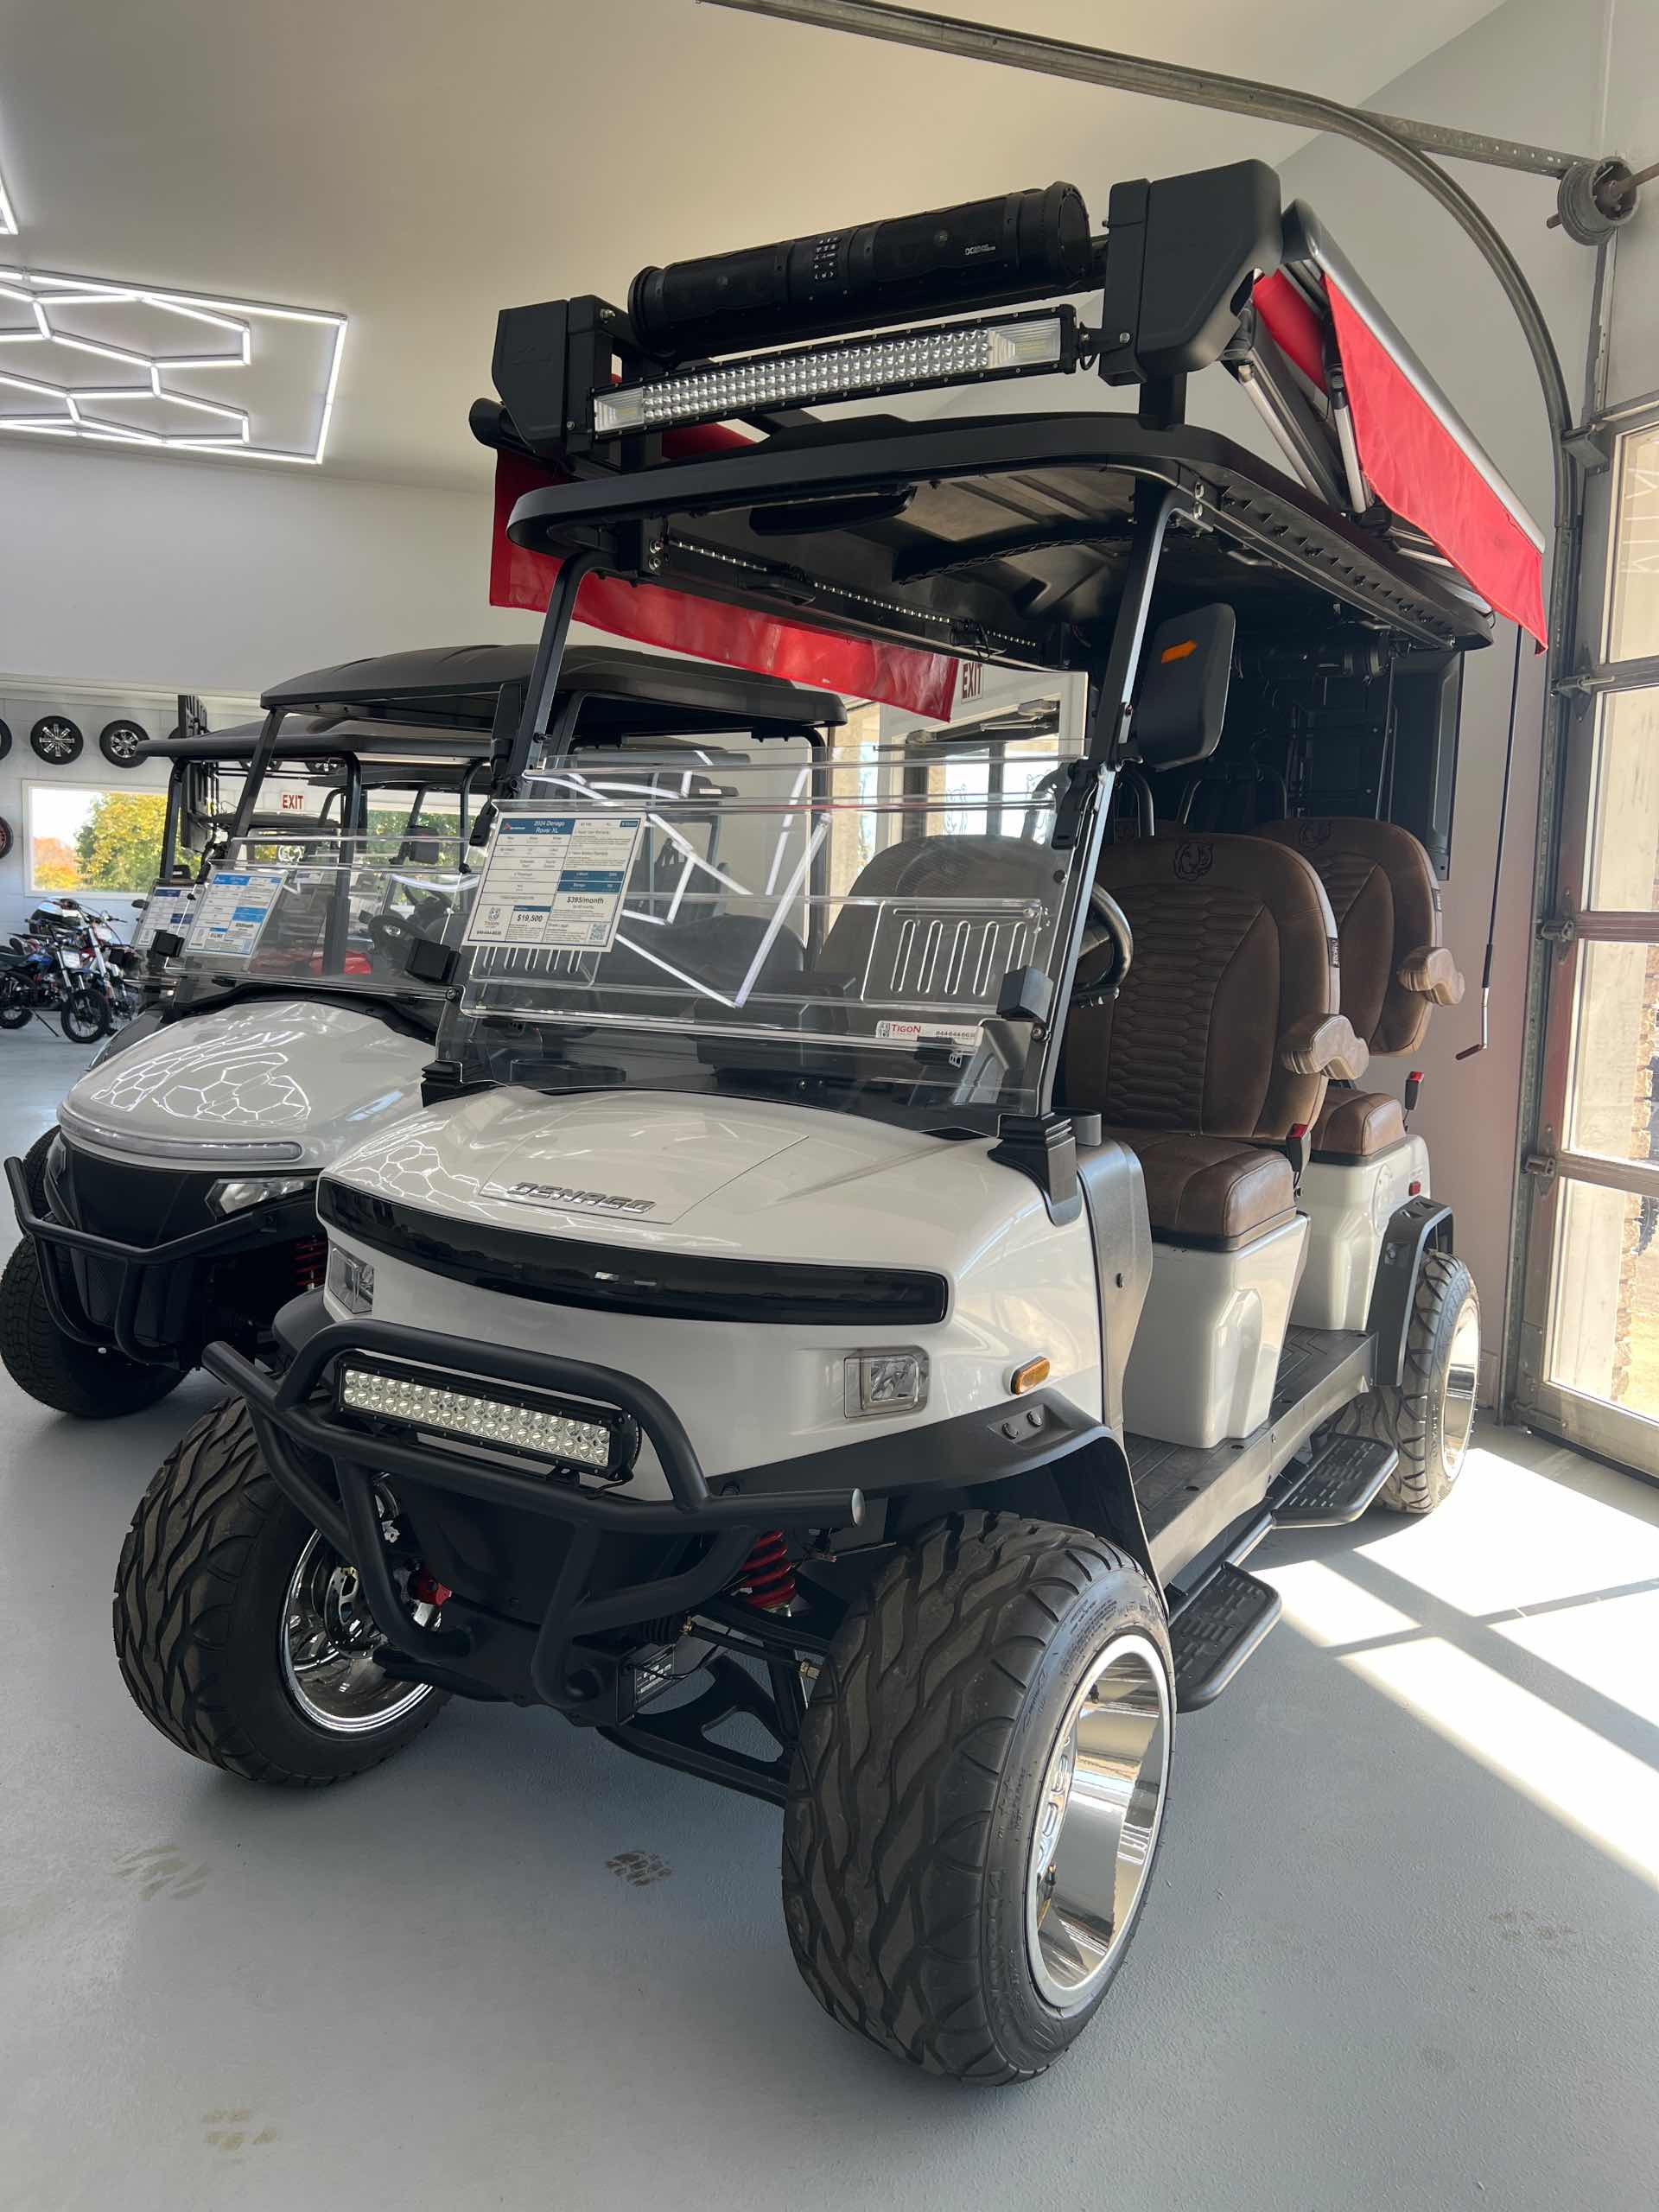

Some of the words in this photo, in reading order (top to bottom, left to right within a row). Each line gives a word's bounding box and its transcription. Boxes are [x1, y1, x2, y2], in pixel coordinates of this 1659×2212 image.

[962, 663, 982, 698] EXIT
[282, 794, 304, 810] EXIT
[566, 896, 604, 905] $395/month
[517, 913, 543, 922] $19,500
[891, 1024, 921, 1033] TIGON
[507, 1182, 657, 1213] DENAGO
